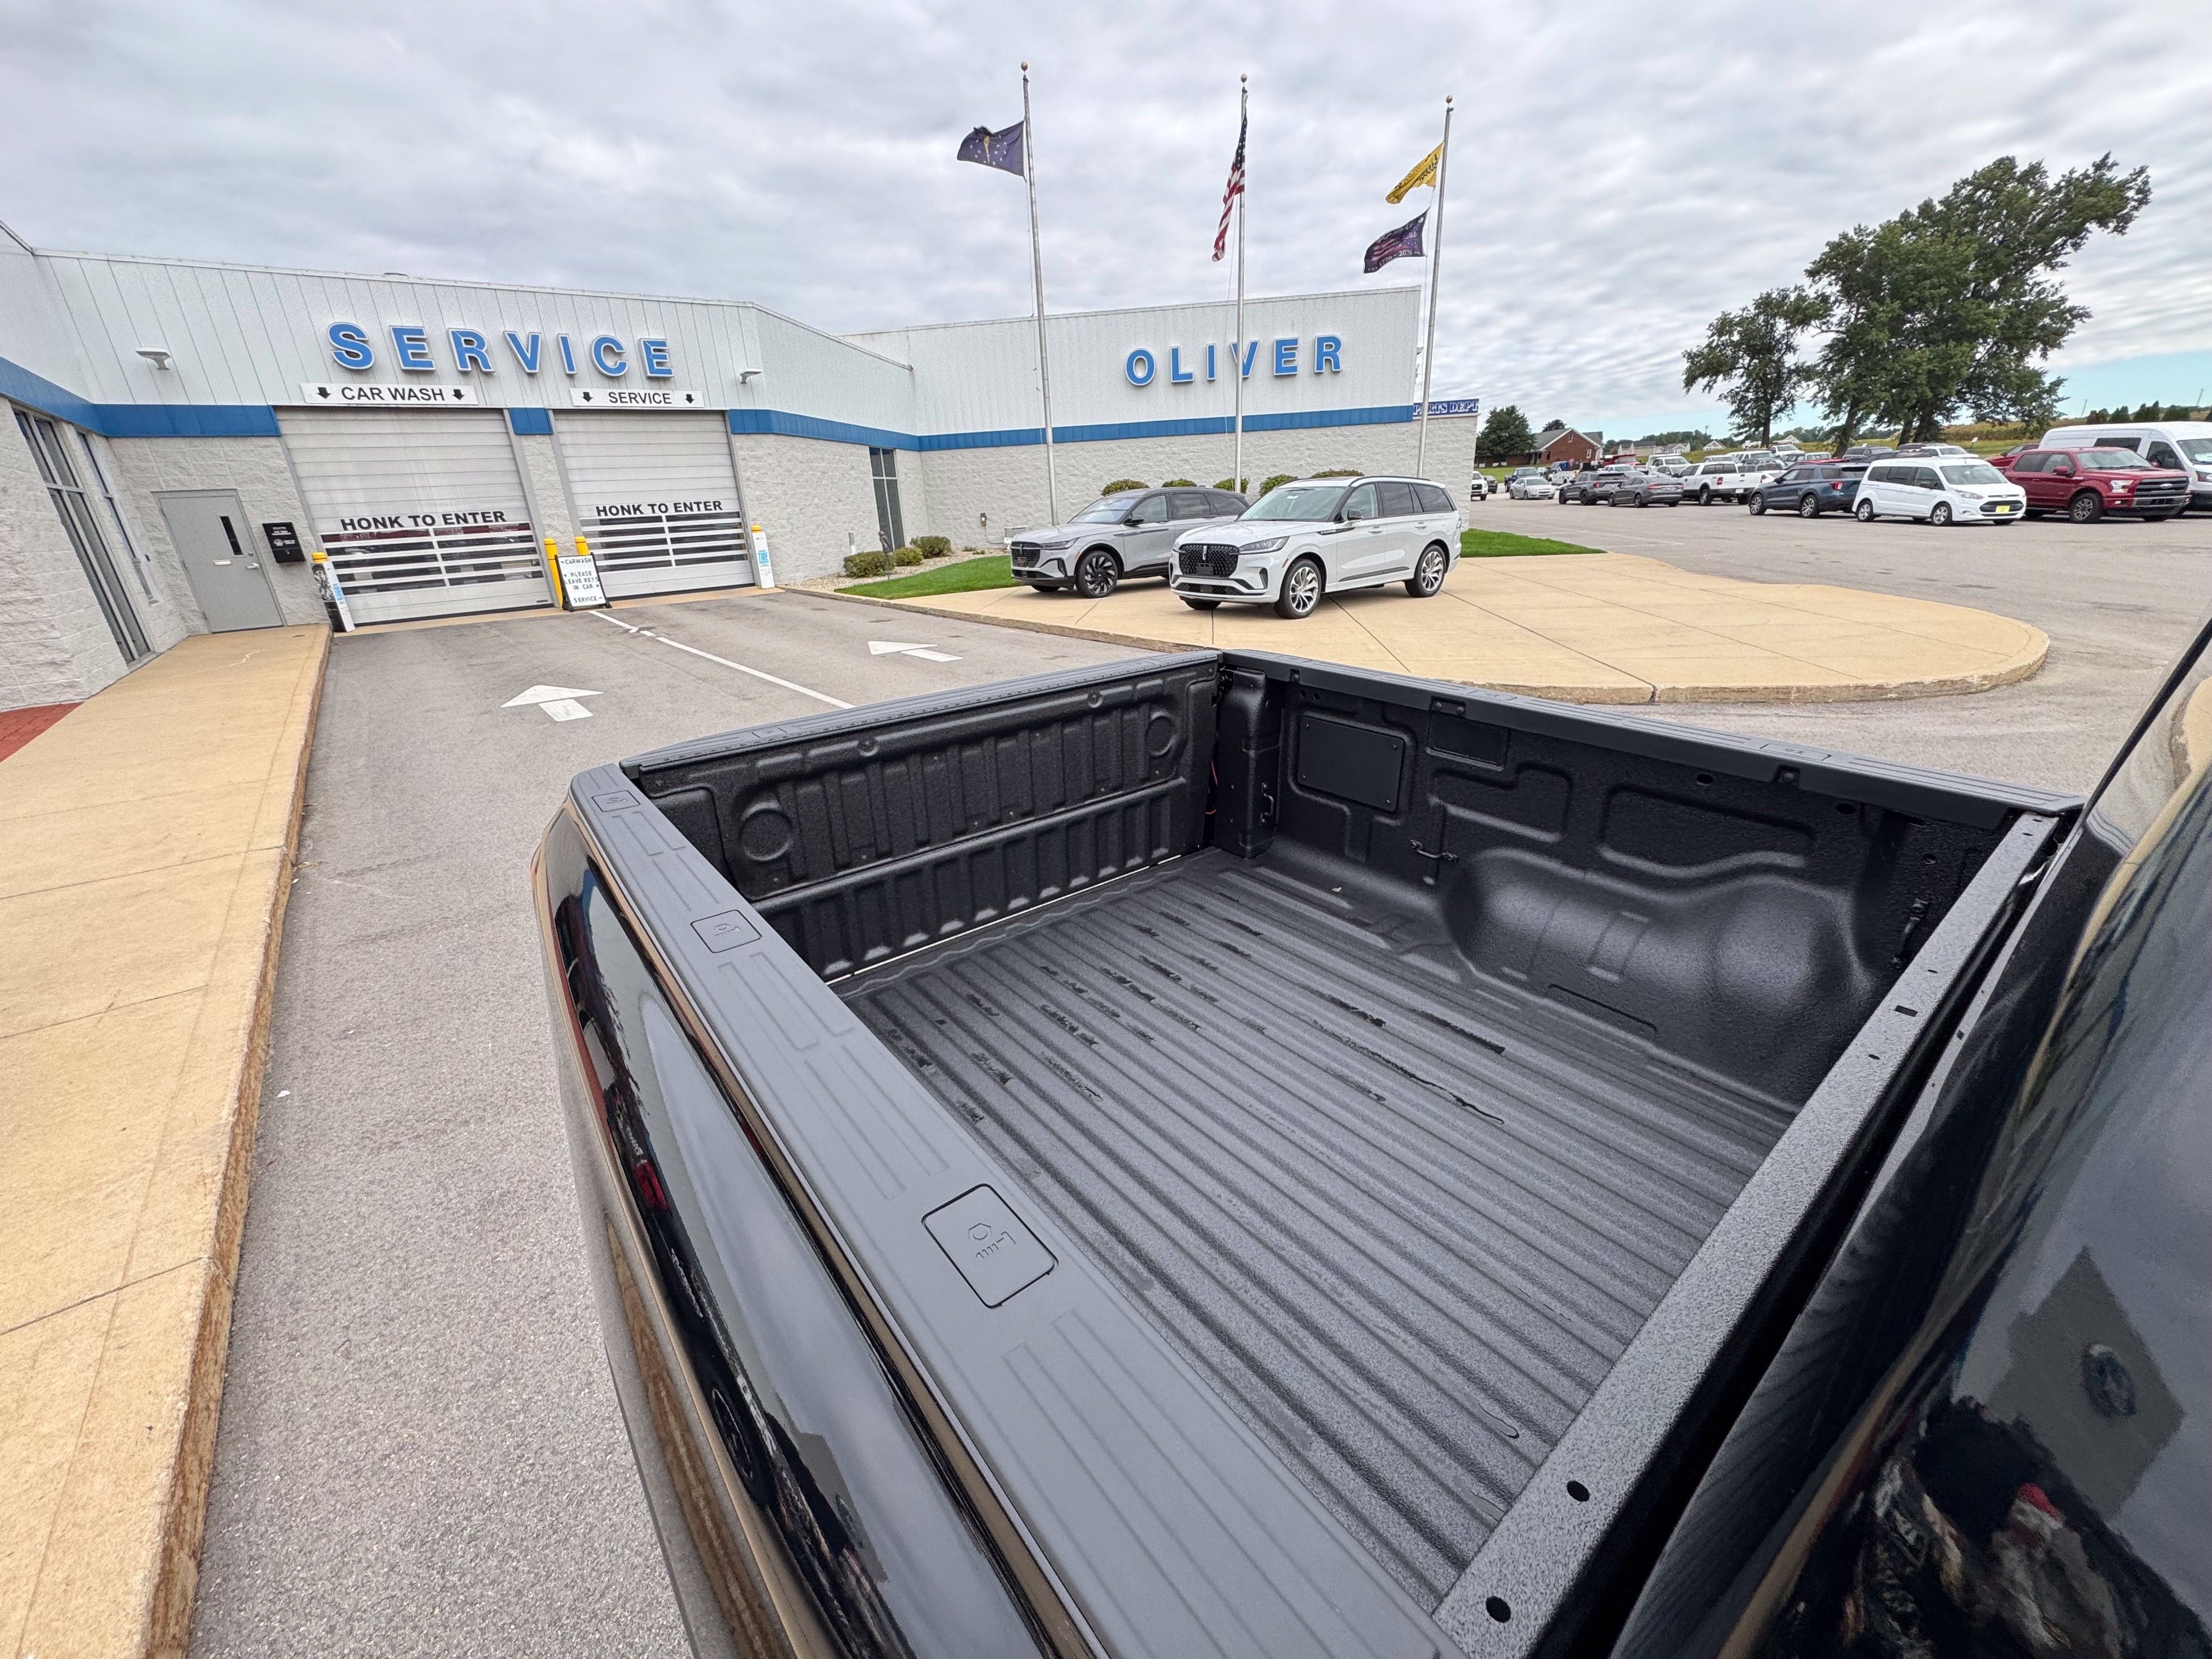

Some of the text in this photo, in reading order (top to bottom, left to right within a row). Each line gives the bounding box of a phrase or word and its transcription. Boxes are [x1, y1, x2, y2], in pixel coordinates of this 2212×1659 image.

[328, 321, 674, 378] SERVICE
[1125, 334, 1342, 386] OLIVER
[341, 386, 445, 402] CAR WASH
[608, 392, 673, 404] SERVICE
[1413, 400, 1479, 415] PRTS DEPT
[596, 500, 724, 517] HONK TO ENTER
[340, 511, 507, 531] HONK TO ENTER
